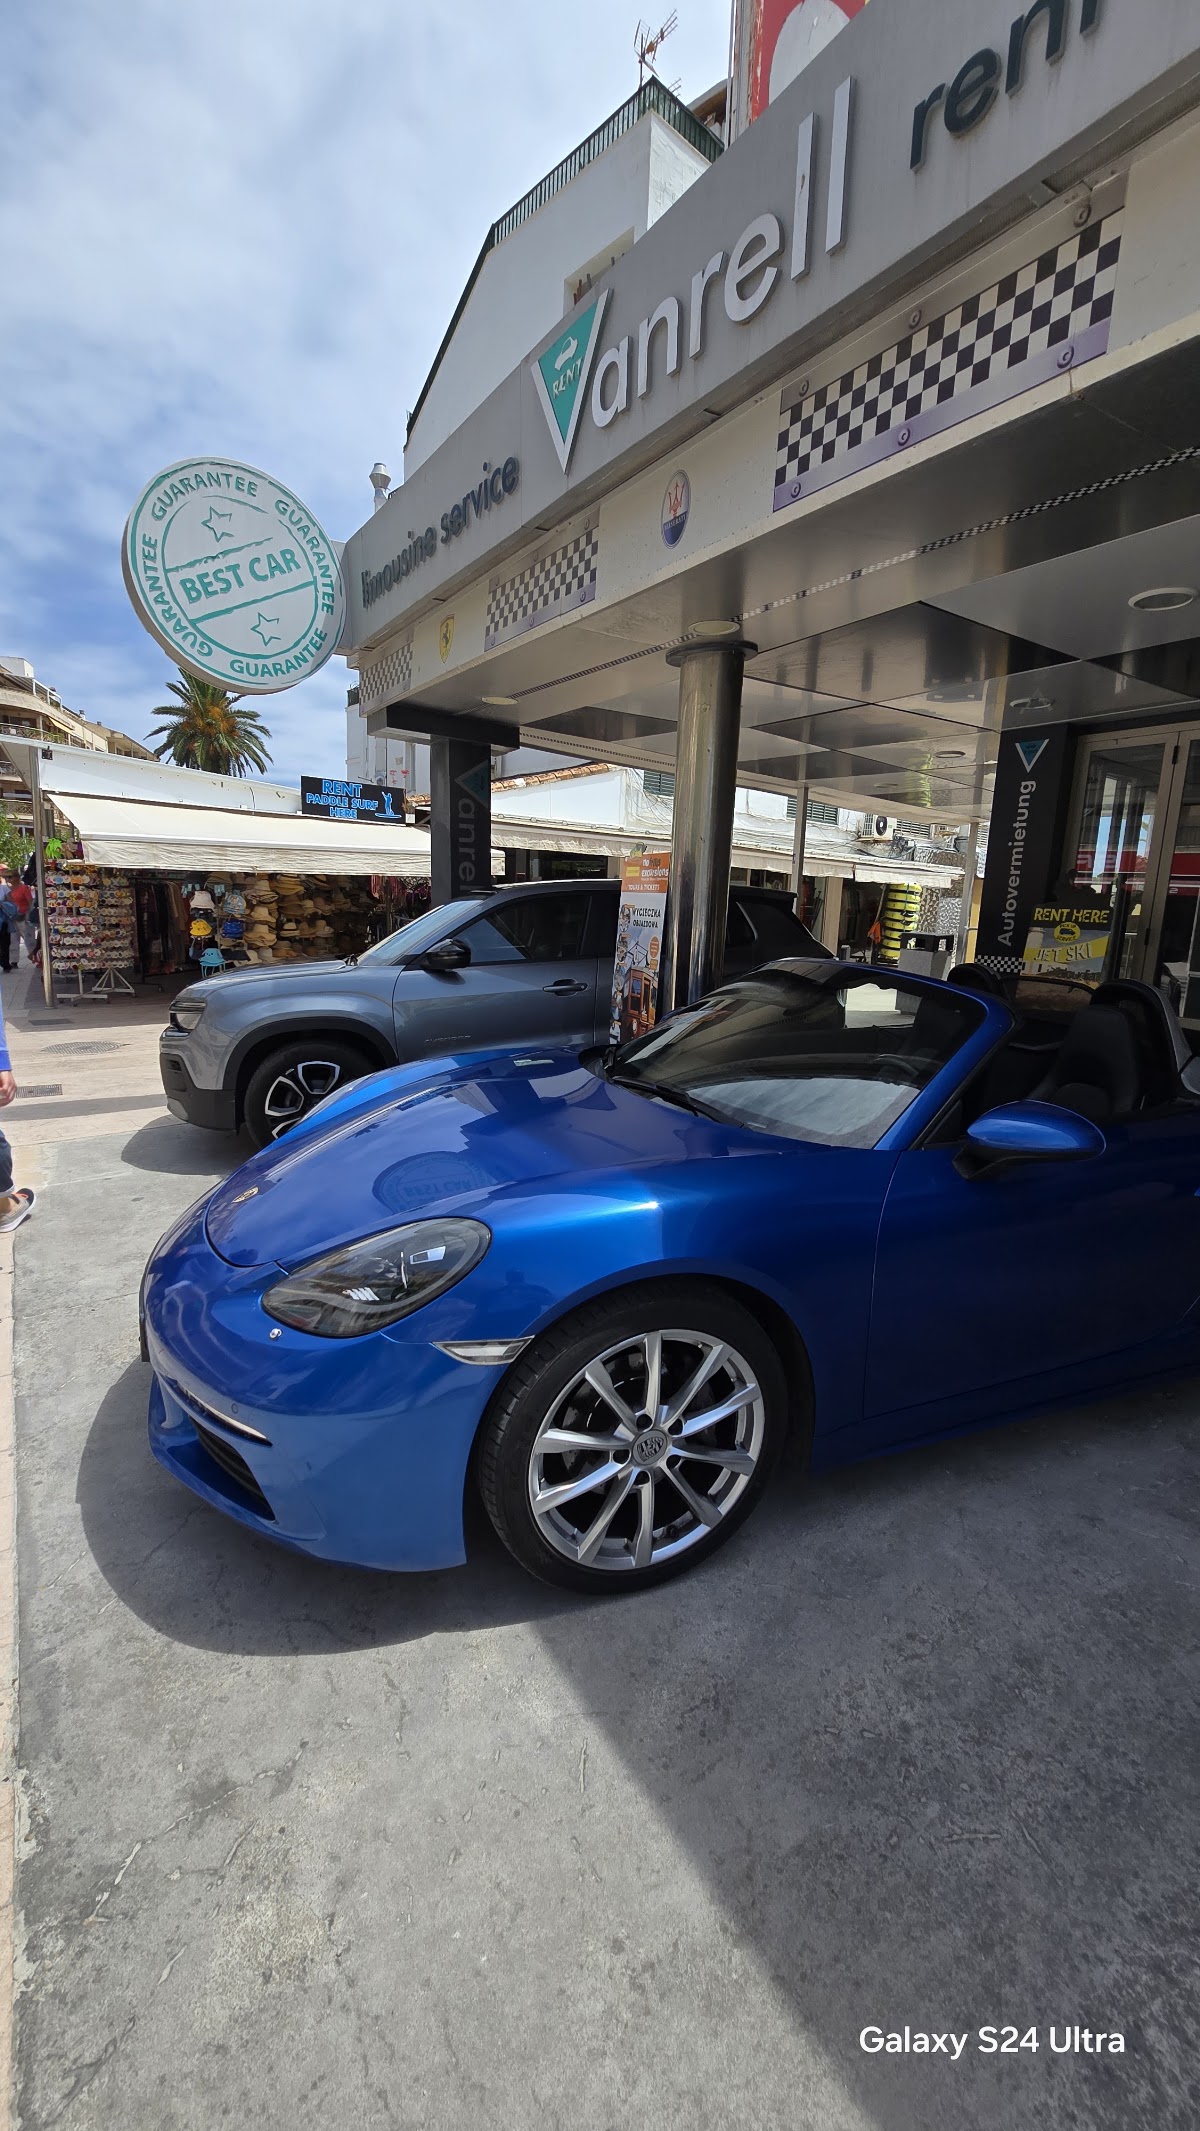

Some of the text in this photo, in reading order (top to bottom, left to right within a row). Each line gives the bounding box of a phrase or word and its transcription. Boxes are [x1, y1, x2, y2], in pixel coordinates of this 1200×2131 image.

[909, 0, 1099, 170] ren
[552, 356, 584, 399] RENT
[151, 471, 259, 521] GUARANTEE
[274, 499, 335, 616] GUARANTEE
[361, 456, 520, 610] limousine service
[142, 533, 213, 657] GUARANTEE
[178, 548, 302, 604] BEST CAR
[229, 627, 328, 678] GUARANTEE
[306, 793, 378, 810] PADDLE SURF
[322, 779, 362, 797] RENT
[329, 807, 358, 819] HERE
[453, 759, 489, 891] Vanrel
[997, 780, 1037, 947] Autovermietung
[1033, 907, 1110, 923] RENT HERE
[1034, 943, 1091, 962] JET SKI
